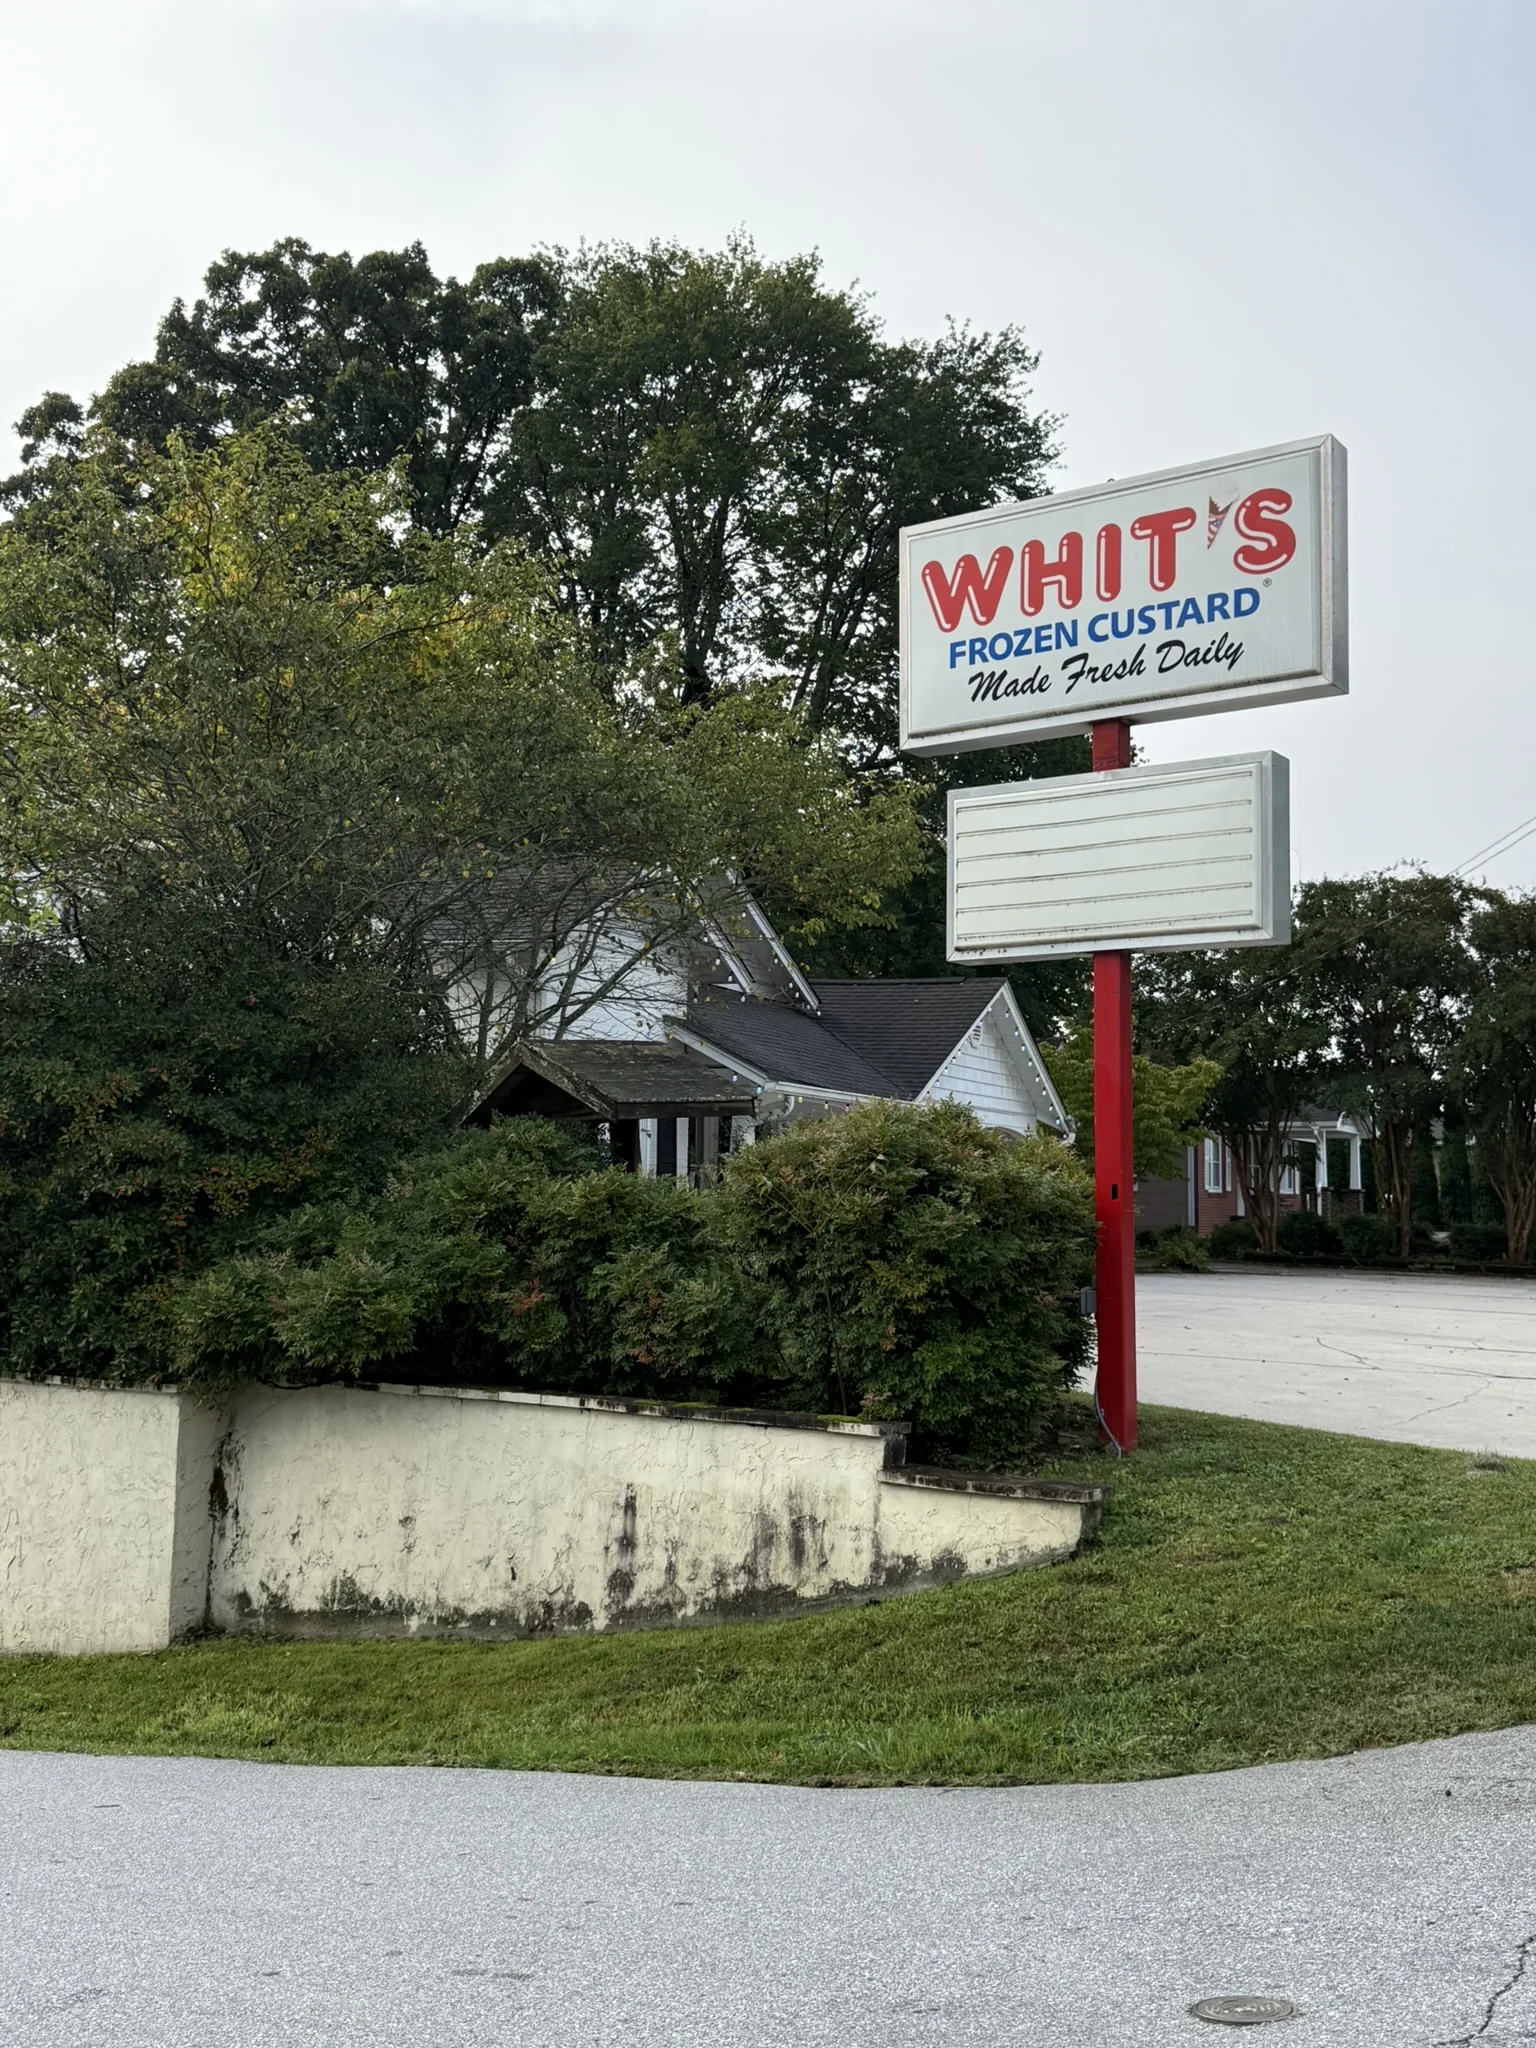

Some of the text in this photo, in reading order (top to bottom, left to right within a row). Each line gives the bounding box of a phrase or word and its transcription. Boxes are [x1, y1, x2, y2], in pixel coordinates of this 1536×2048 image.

[921, 481, 1297, 633] WHIT'S
[949, 587, 1260, 669] FROZEN CUSTARD
[968, 631, 1245, 703] Made Fresh Daily
